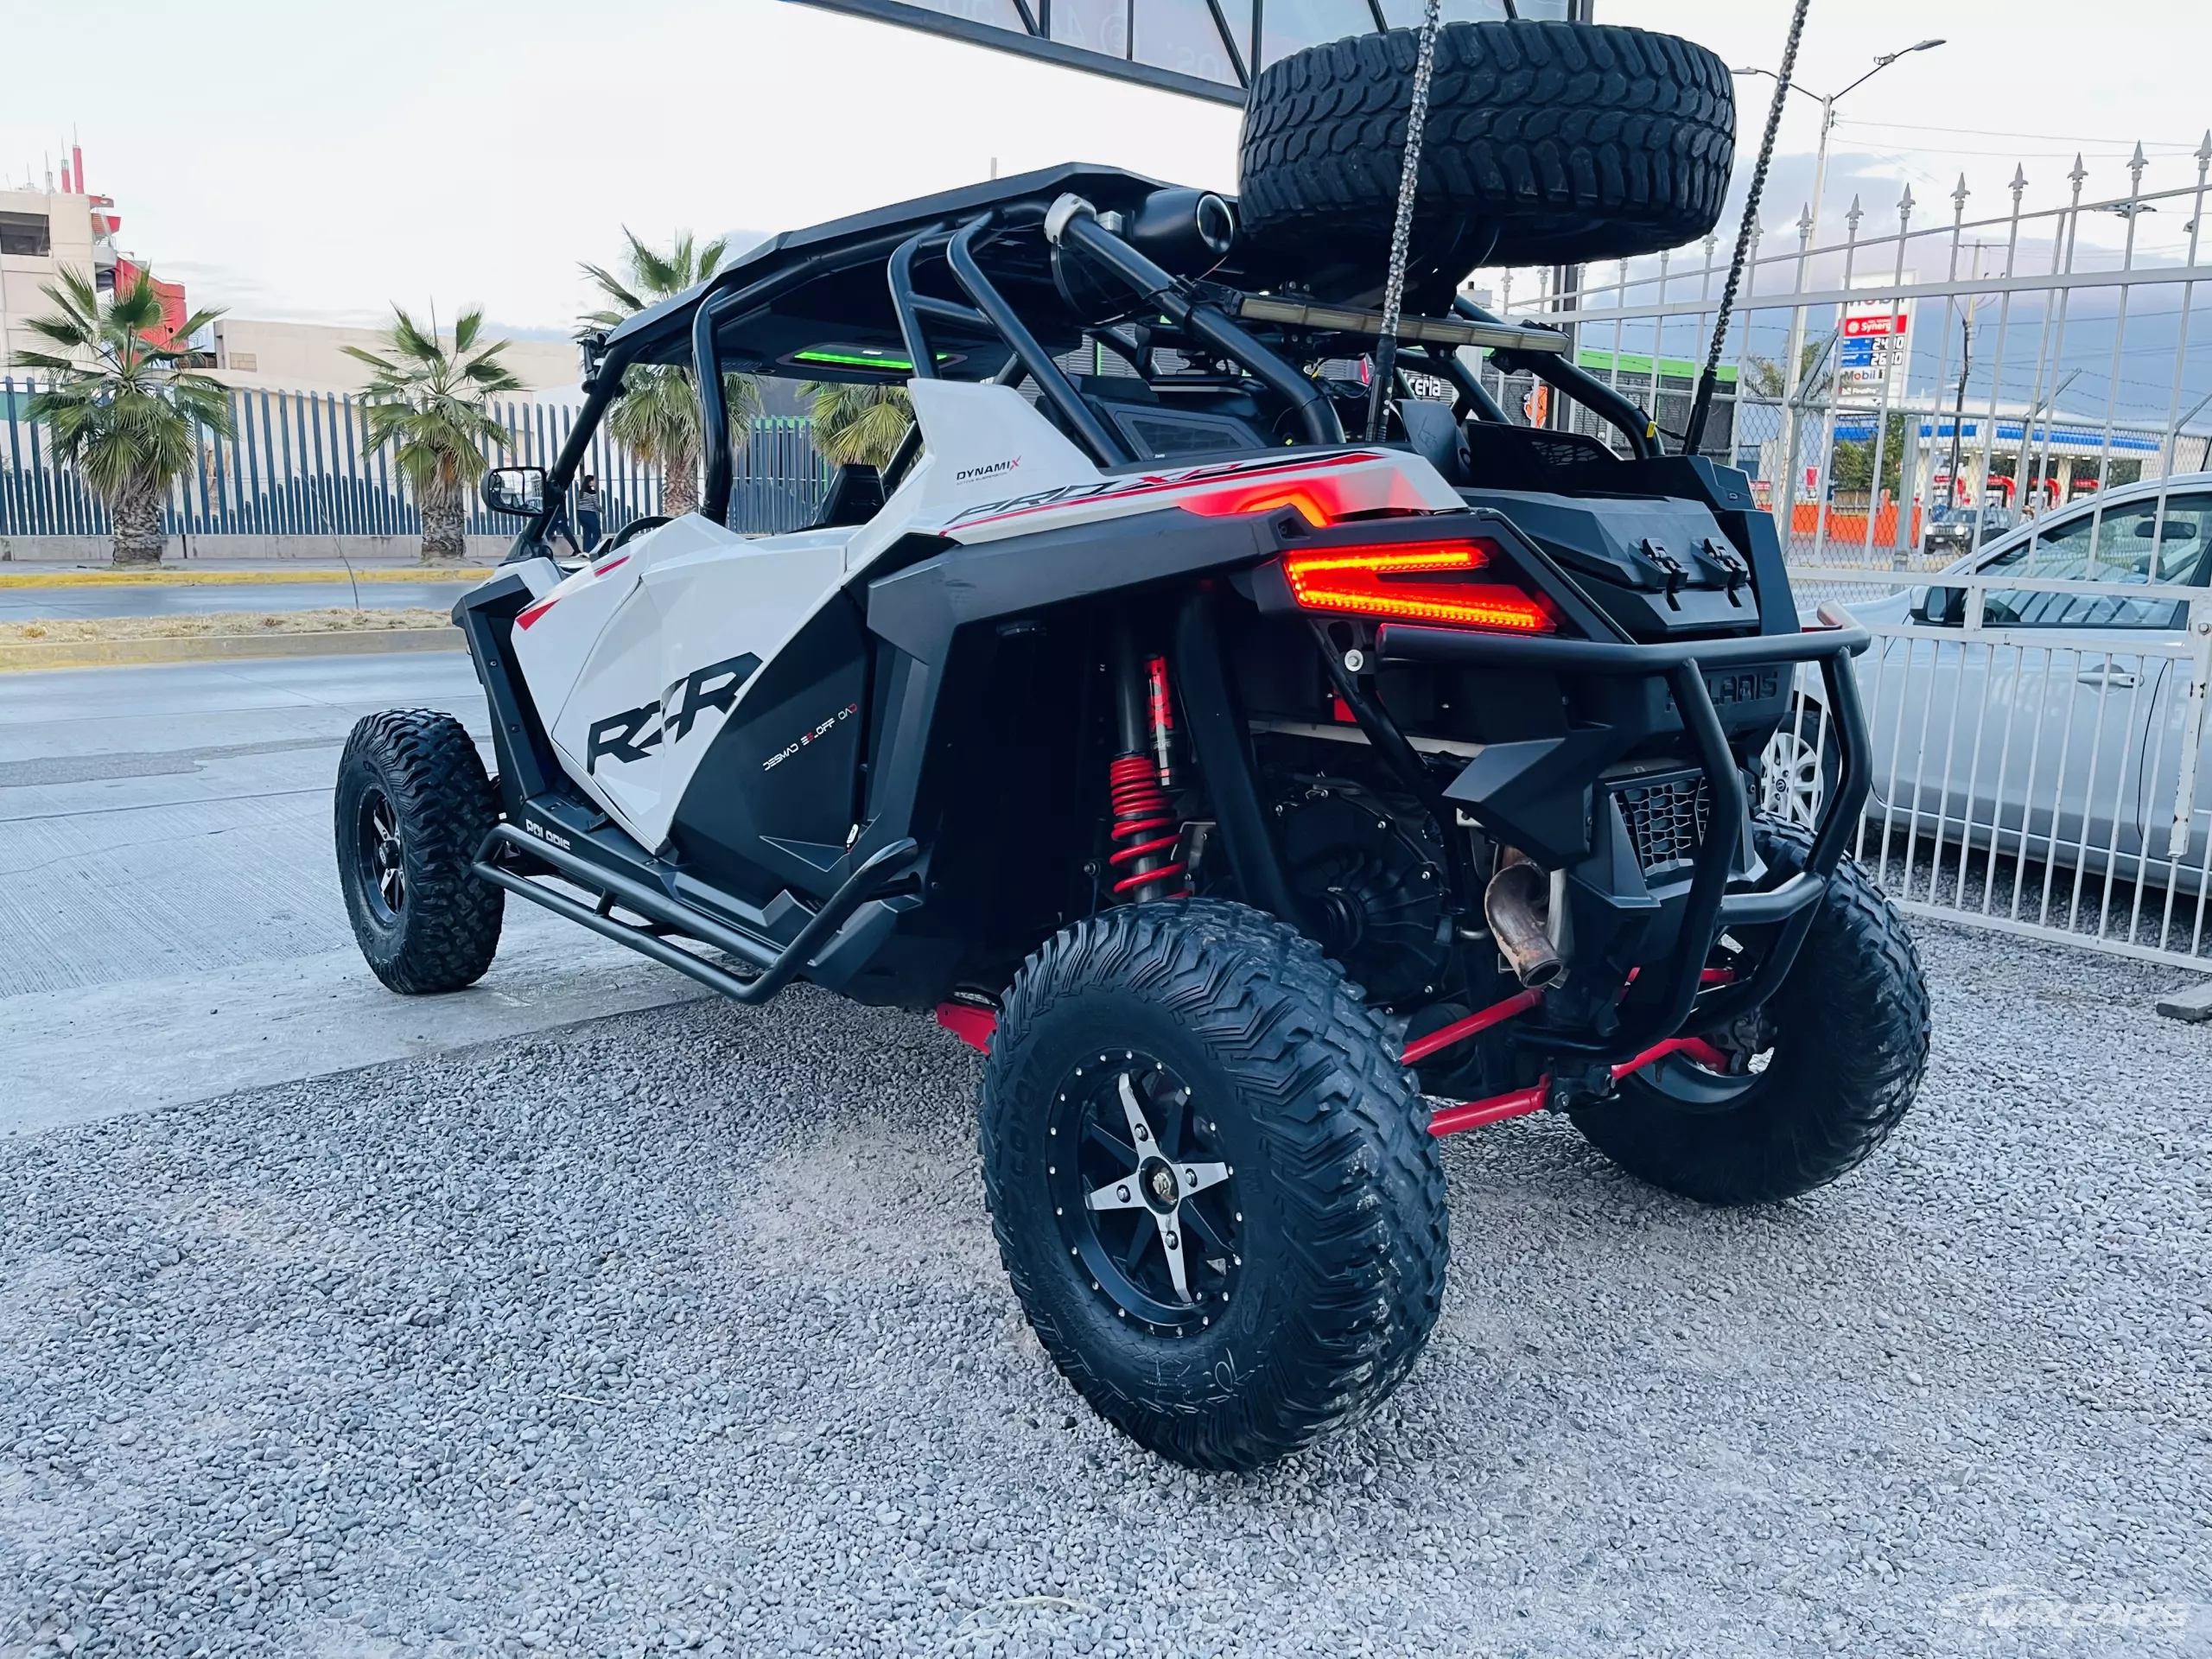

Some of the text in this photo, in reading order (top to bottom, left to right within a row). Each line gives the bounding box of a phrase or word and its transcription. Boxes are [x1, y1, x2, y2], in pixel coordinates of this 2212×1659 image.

[1860, 321, 1891, 334] Synerg
[1844, 369, 1876, 381] Mobil
[956, 454, 1022, 480] DYNAMIX
[943, 480, 1123, 527] PRO
[587, 651, 764, 777] RZR
